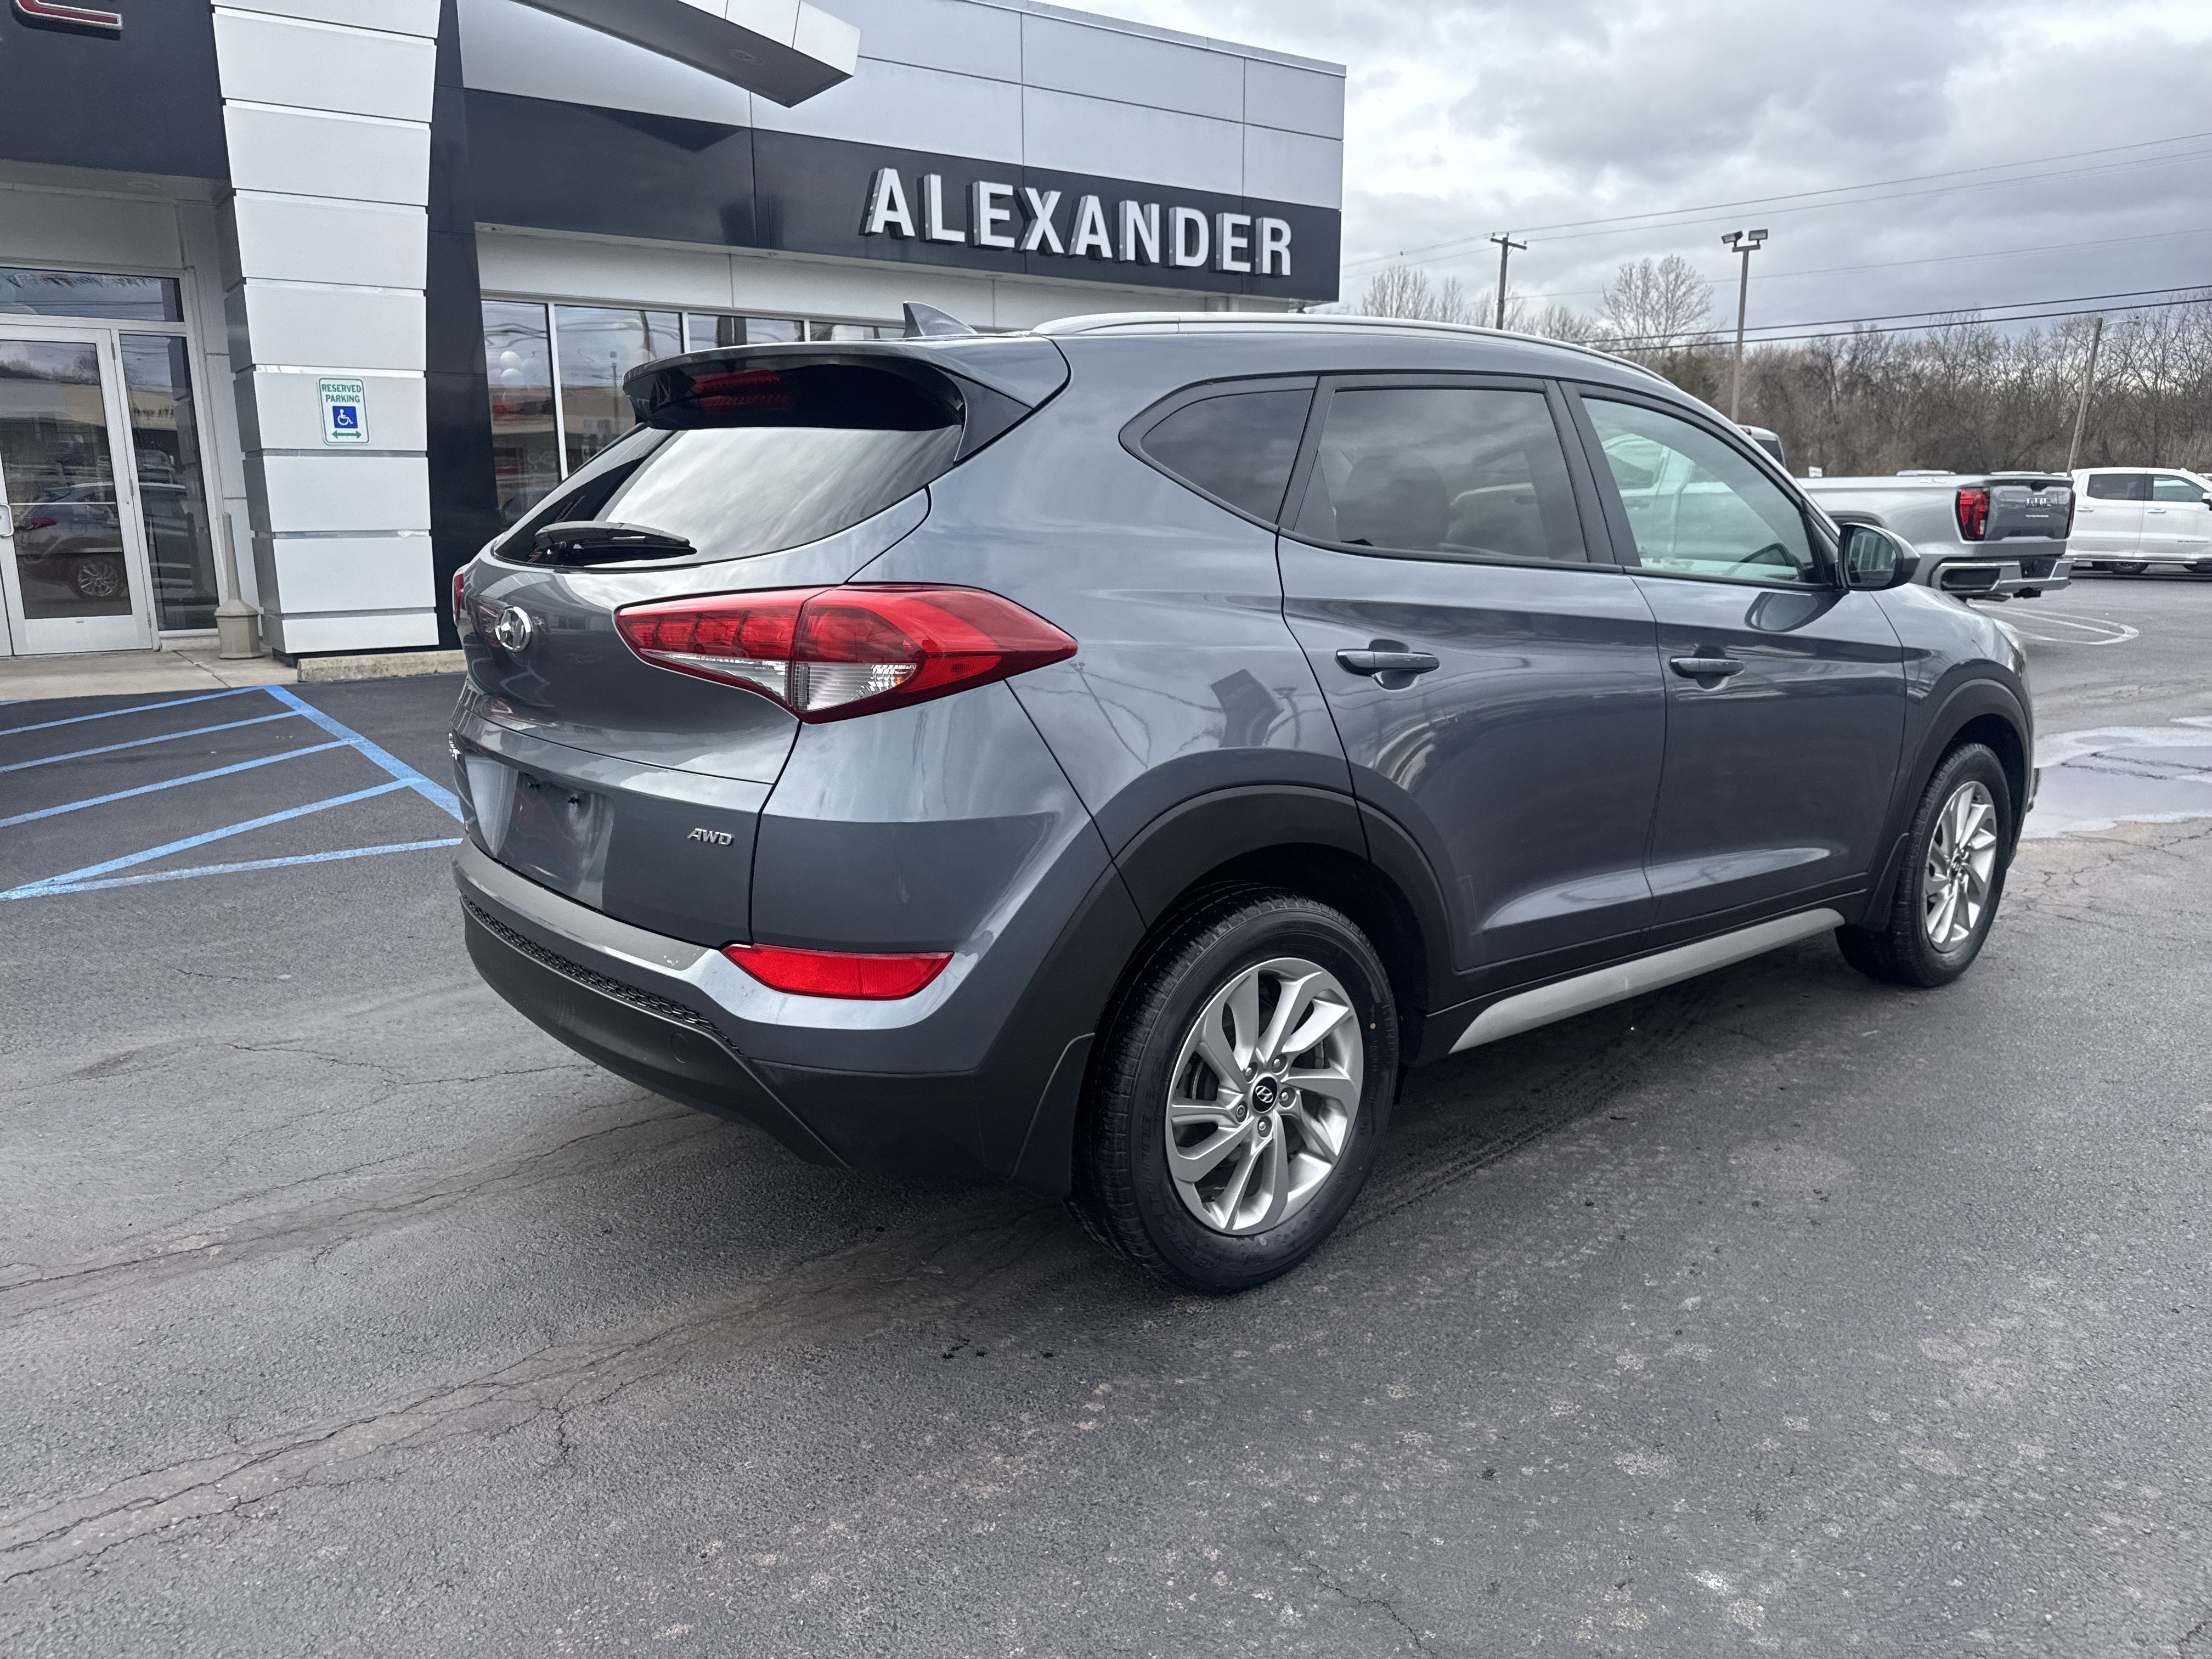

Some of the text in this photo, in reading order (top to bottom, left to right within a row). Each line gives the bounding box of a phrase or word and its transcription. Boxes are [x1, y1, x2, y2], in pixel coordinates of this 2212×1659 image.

[865, 167, 1292, 276] ALEXANDER
[321, 383, 362, 393] RESERVED
[325, 394, 360, 403] PARKING
[687, 828, 735, 846] AWD
